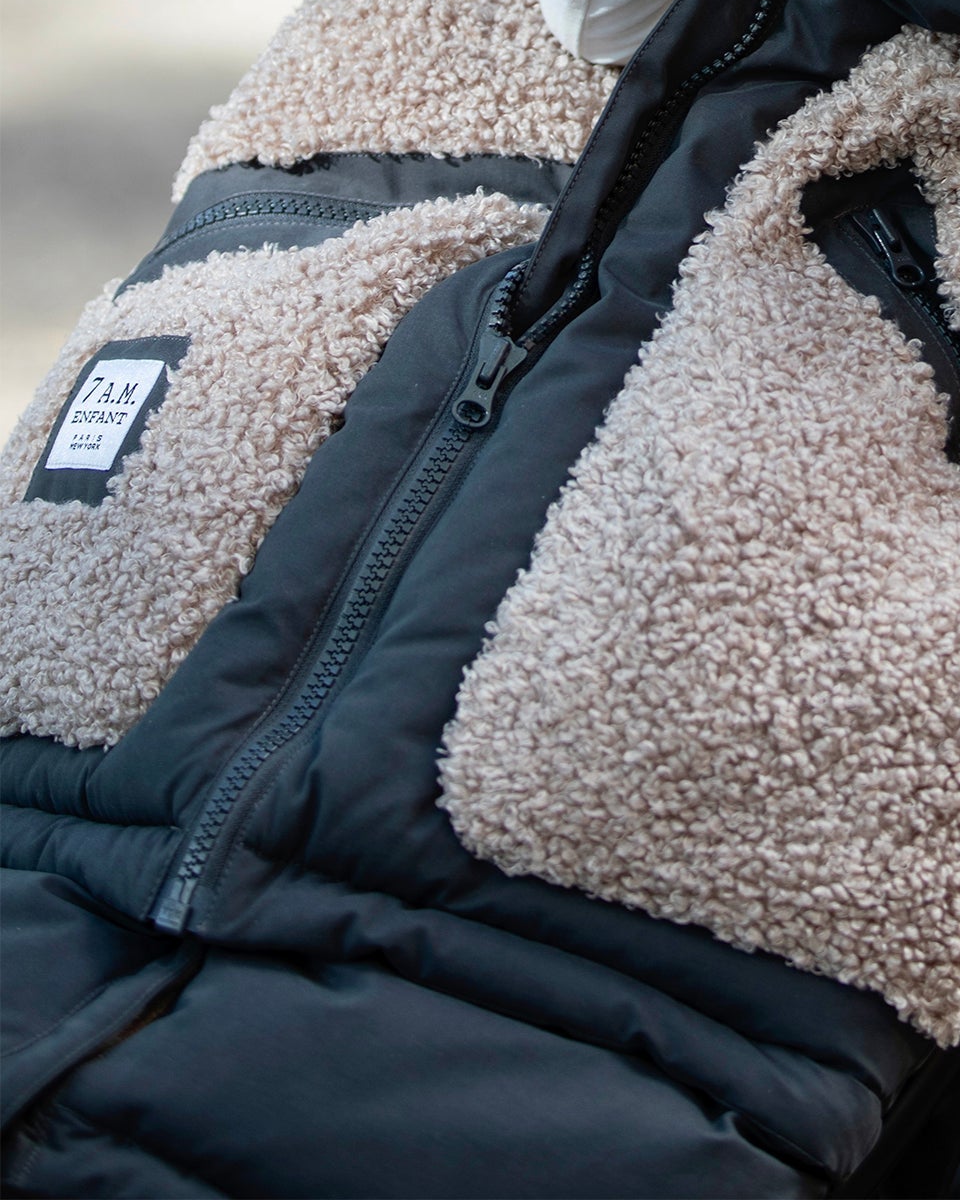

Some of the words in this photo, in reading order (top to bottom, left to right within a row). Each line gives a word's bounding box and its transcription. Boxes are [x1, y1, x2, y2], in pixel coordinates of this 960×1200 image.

[82, 377, 105, 403] 7
[97, 382, 139, 405] A.M.
[71, 411, 128, 425] ENFANT
